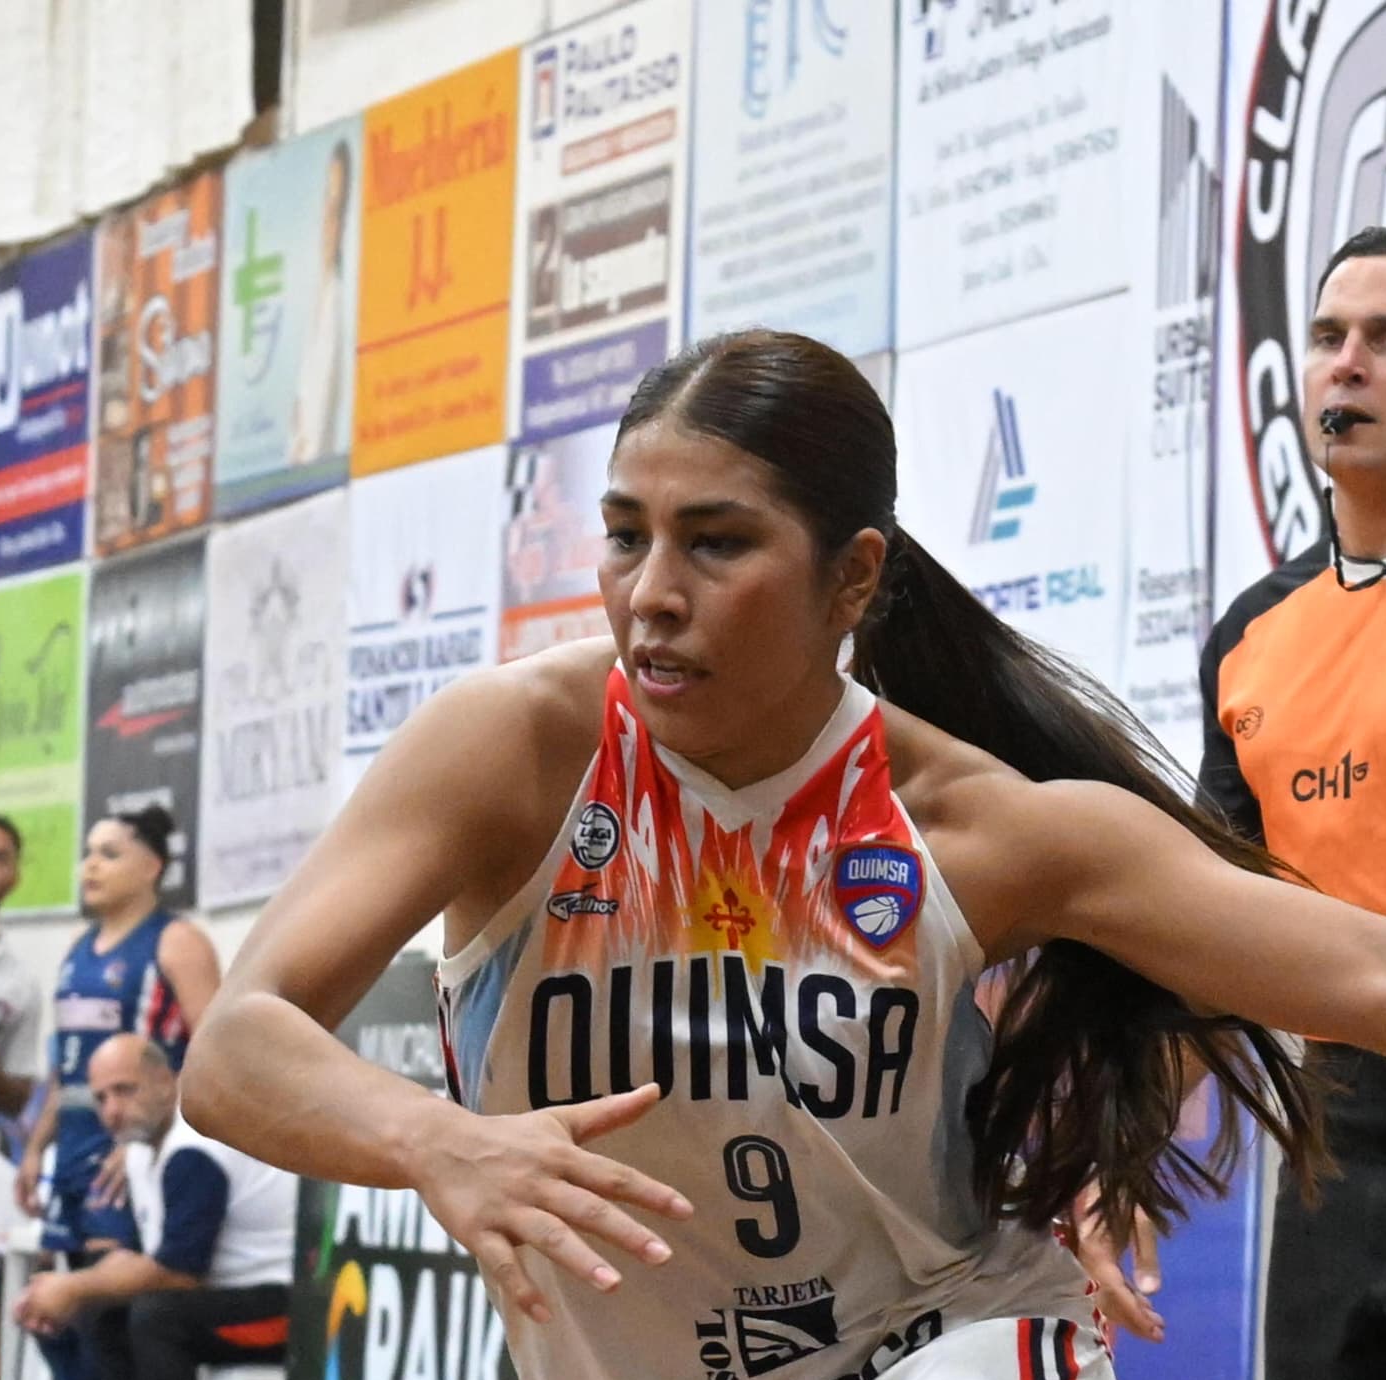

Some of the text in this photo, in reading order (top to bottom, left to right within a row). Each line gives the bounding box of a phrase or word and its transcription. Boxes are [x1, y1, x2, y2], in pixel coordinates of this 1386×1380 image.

[1047, 566, 1104, 607] REAL
[849, 858, 908, 884] QUIMSA
[528, 956, 919, 1119] QUIMSA
[723, 1135, 801, 1259] 9
[733, 1276, 835, 1307] TARJETA
